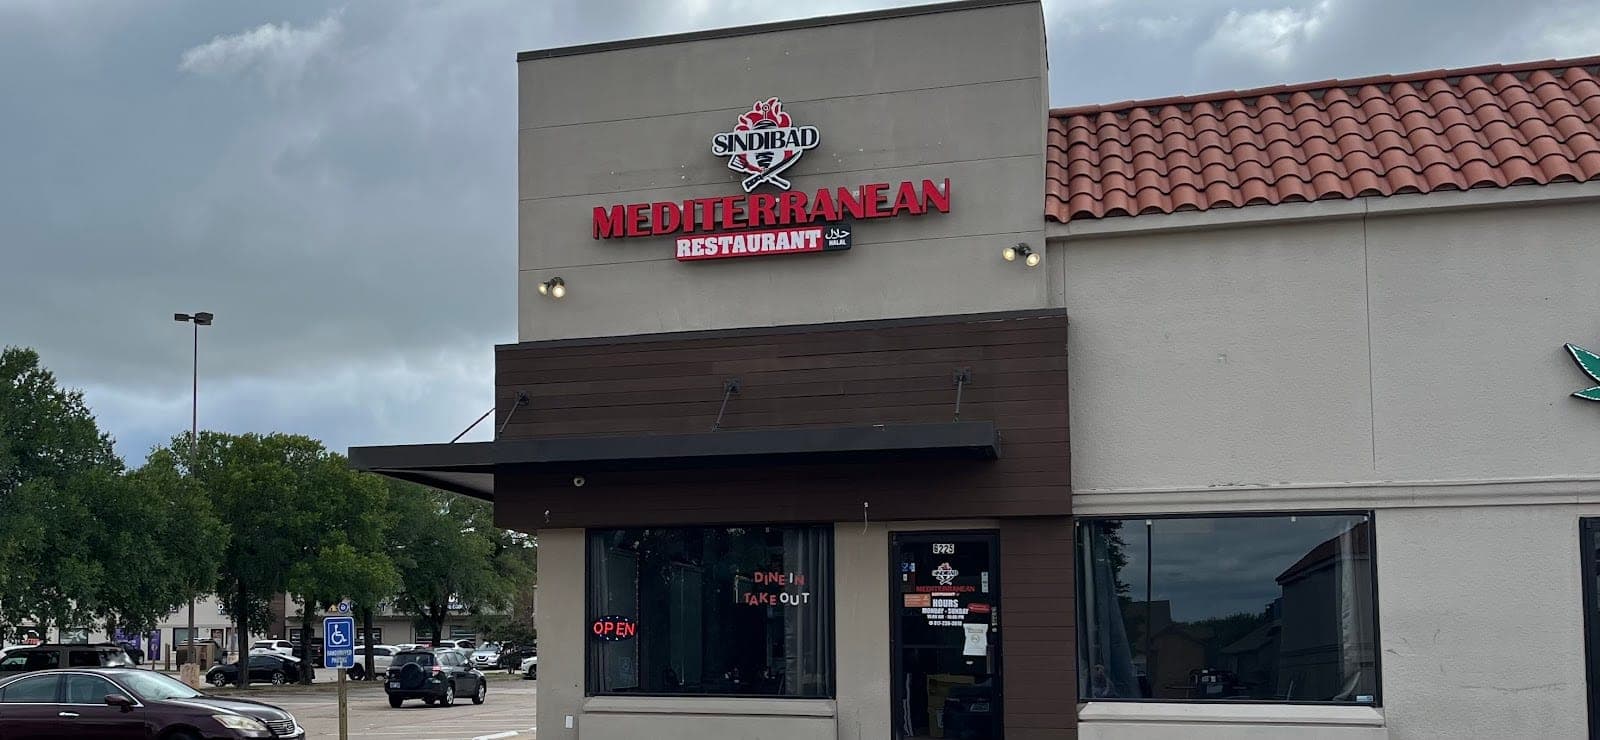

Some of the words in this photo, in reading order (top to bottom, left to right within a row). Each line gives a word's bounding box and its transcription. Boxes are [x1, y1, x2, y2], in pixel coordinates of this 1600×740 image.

[713, 127, 819, 153] SINDIBAD
[593, 178, 951, 240] MEDITERRANEAN
[825, 228, 850, 240] حلال
[676, 229, 822, 258] RESTAURANT
[754, 571, 786, 586] DINE
[789, 572, 805, 586] IN
[743, 592, 777, 606] TAKE
[779, 592, 810, 606] OUT
[932, 598, 959, 608] HOURS
[593, 621, 636, 637] OPEN
